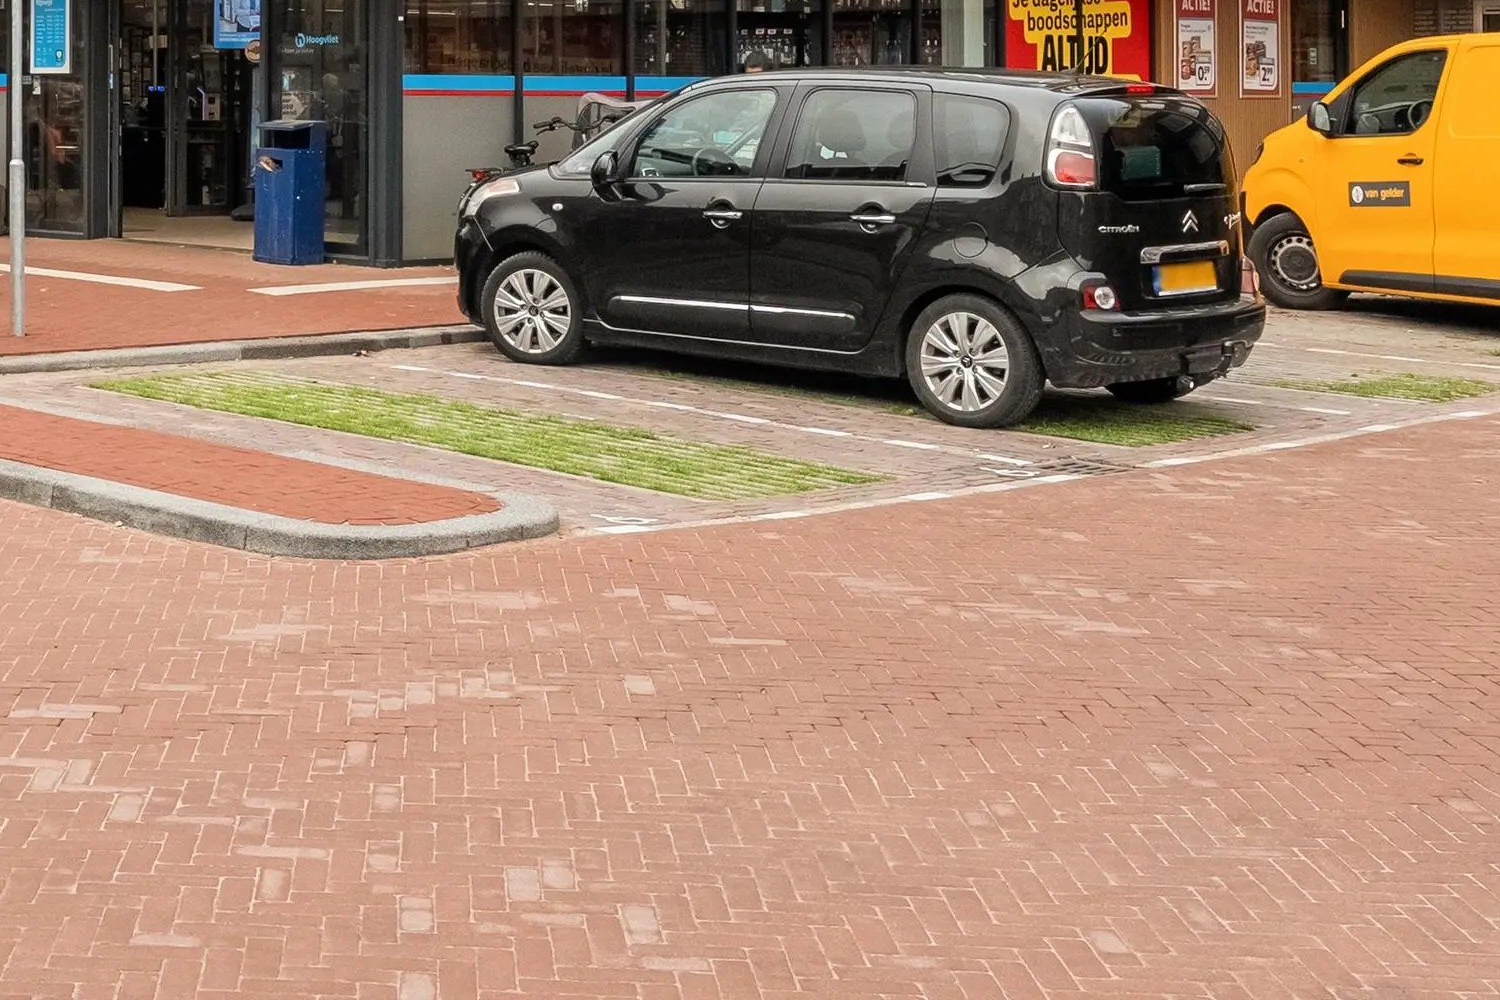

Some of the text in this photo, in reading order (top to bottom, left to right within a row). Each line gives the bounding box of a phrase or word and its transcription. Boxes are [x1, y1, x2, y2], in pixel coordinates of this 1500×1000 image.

[1042, 34, 1109, 75] ALTJD
[1364, 187, 1404, 200] van gelder
